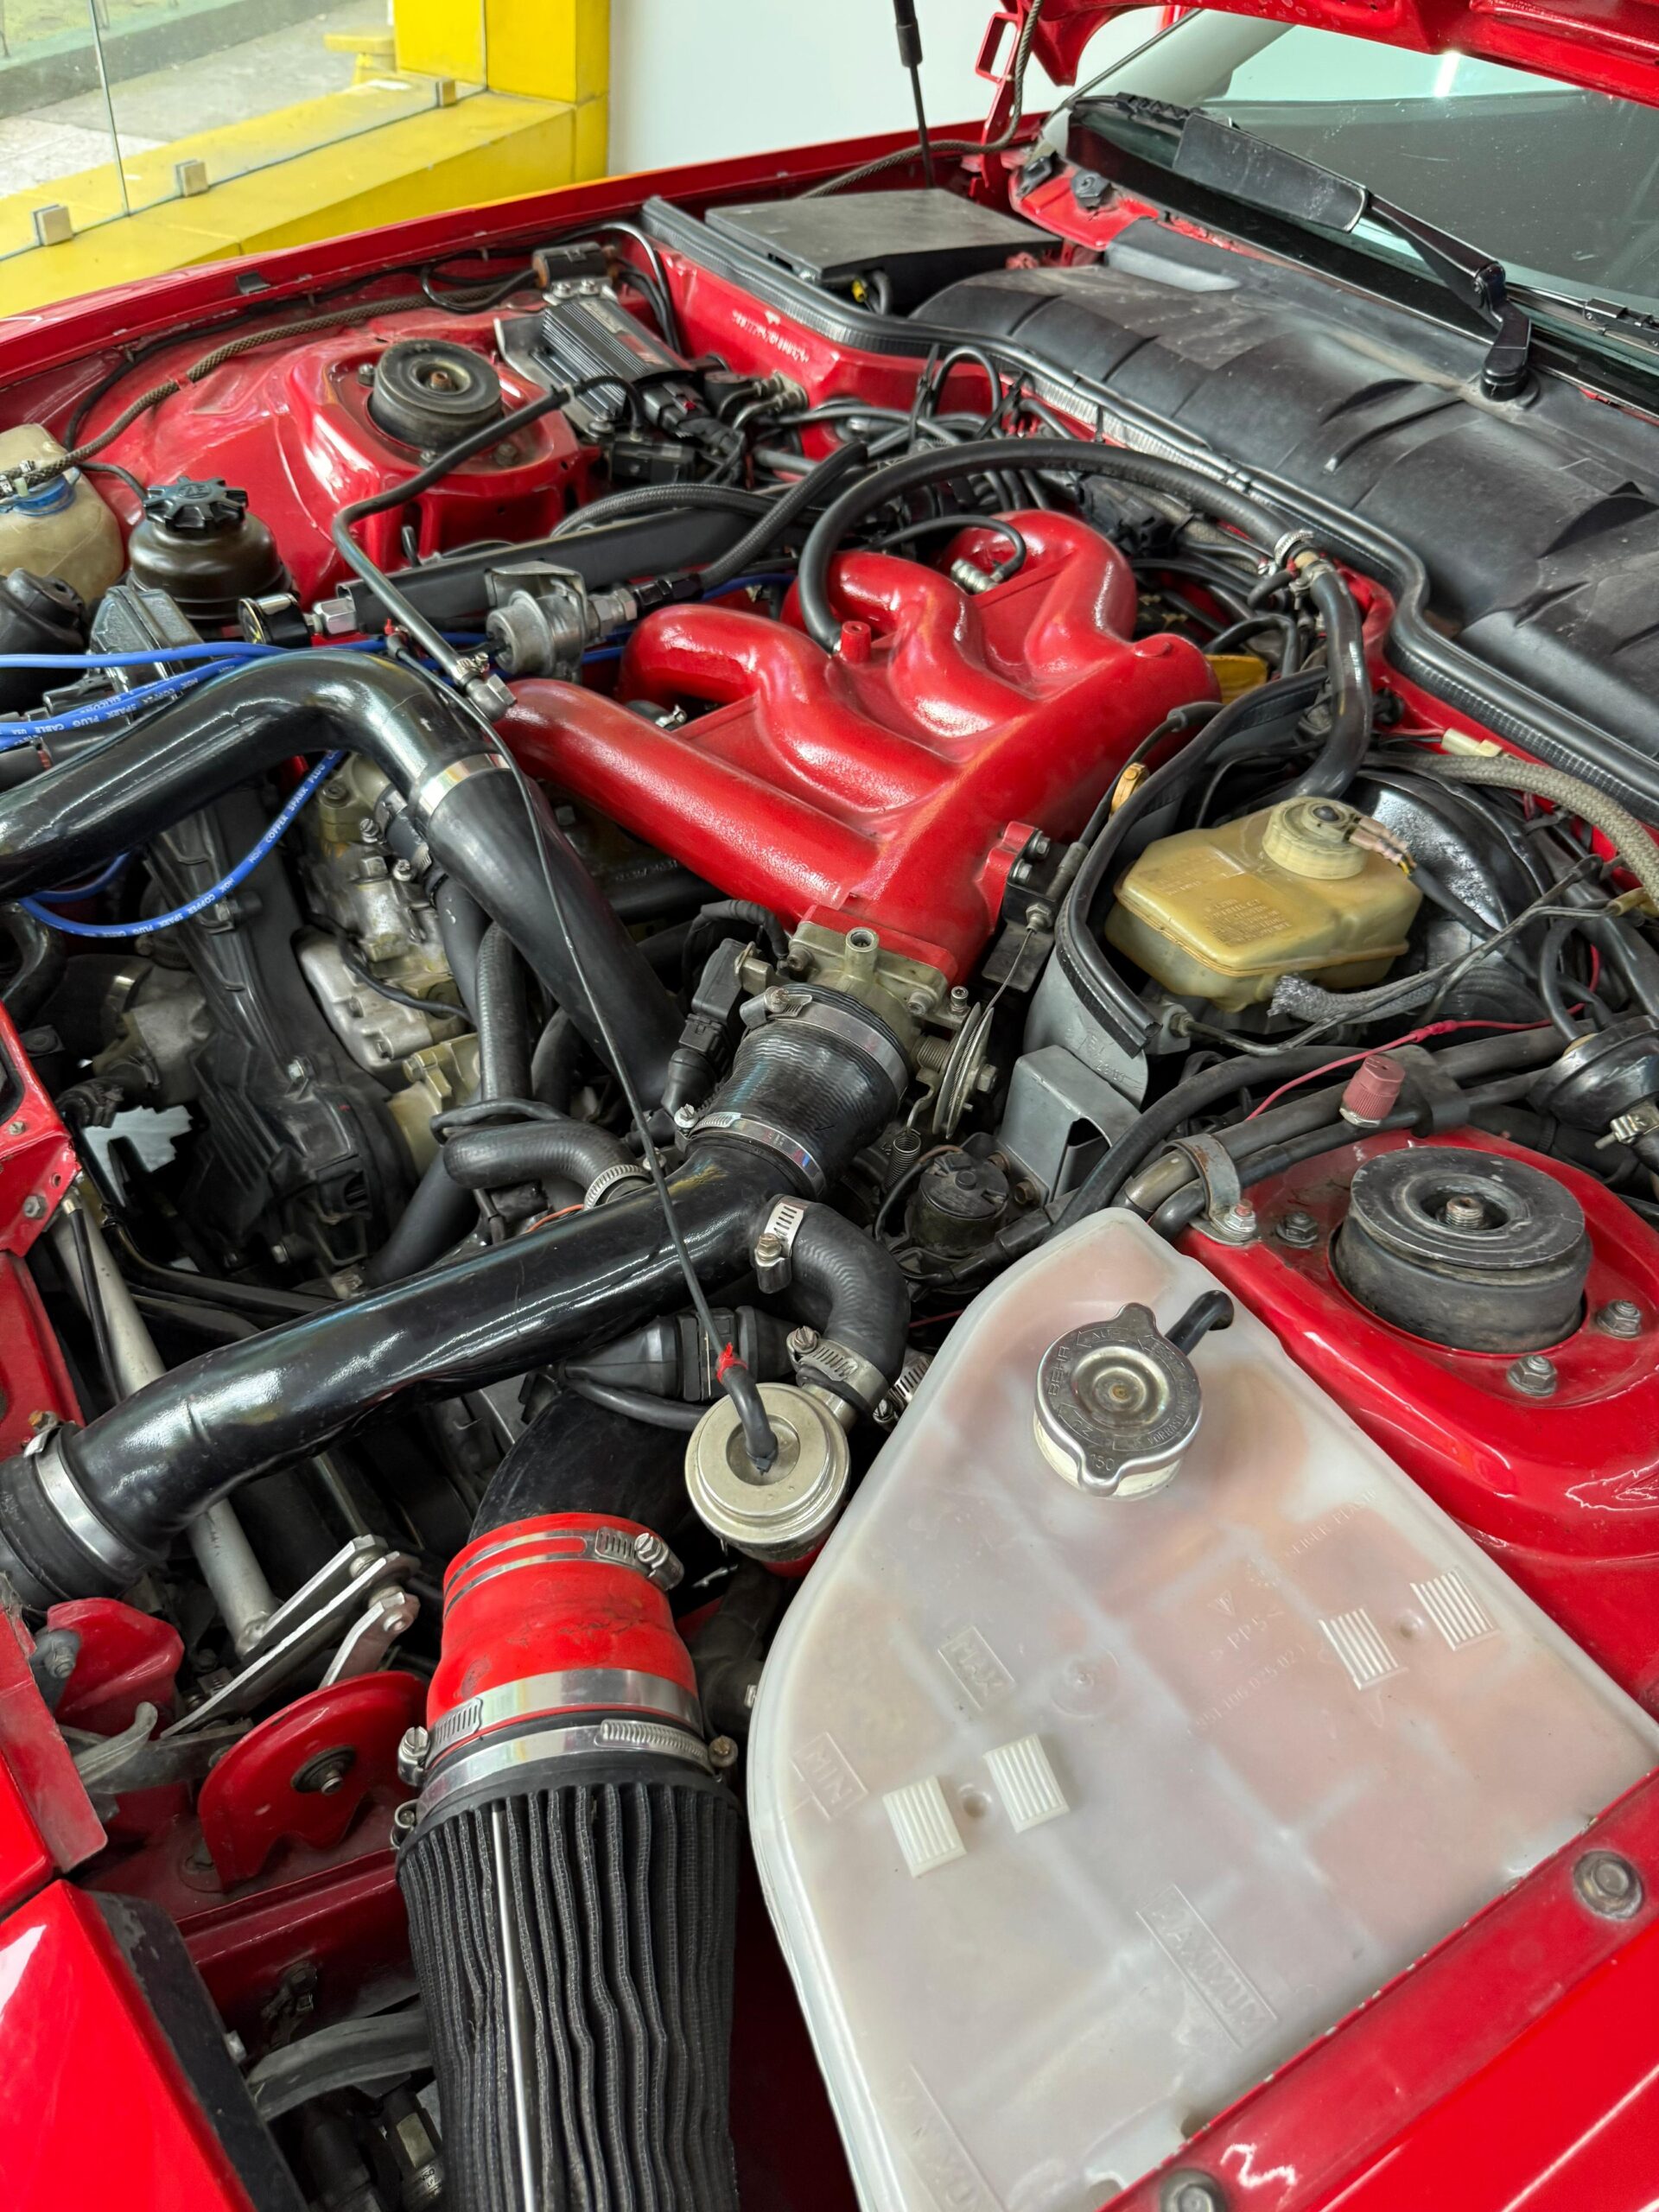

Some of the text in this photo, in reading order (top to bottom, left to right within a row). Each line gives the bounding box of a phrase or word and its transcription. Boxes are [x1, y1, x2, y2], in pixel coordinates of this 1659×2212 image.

[105, 703, 137, 719] SPARK
[35, 722, 65, 734] CABLE
[73, 715, 99, 728] PLUG
[265, 814, 289, 843] COPPER
[288, 786, 308, 811] SPARK
[308, 764, 327, 784] PLUG
[186, 893, 215, 914] COPPER
[158, 912, 183, 927] SPARK
[132, 925, 154, 935] PLUG
[1048, 1345, 1071, 1395] BEHR
[1090, 1453, 1115, 1471] 150
[950, 1641, 1004, 1699] MAX
[804, 1744, 854, 1804] MIN
